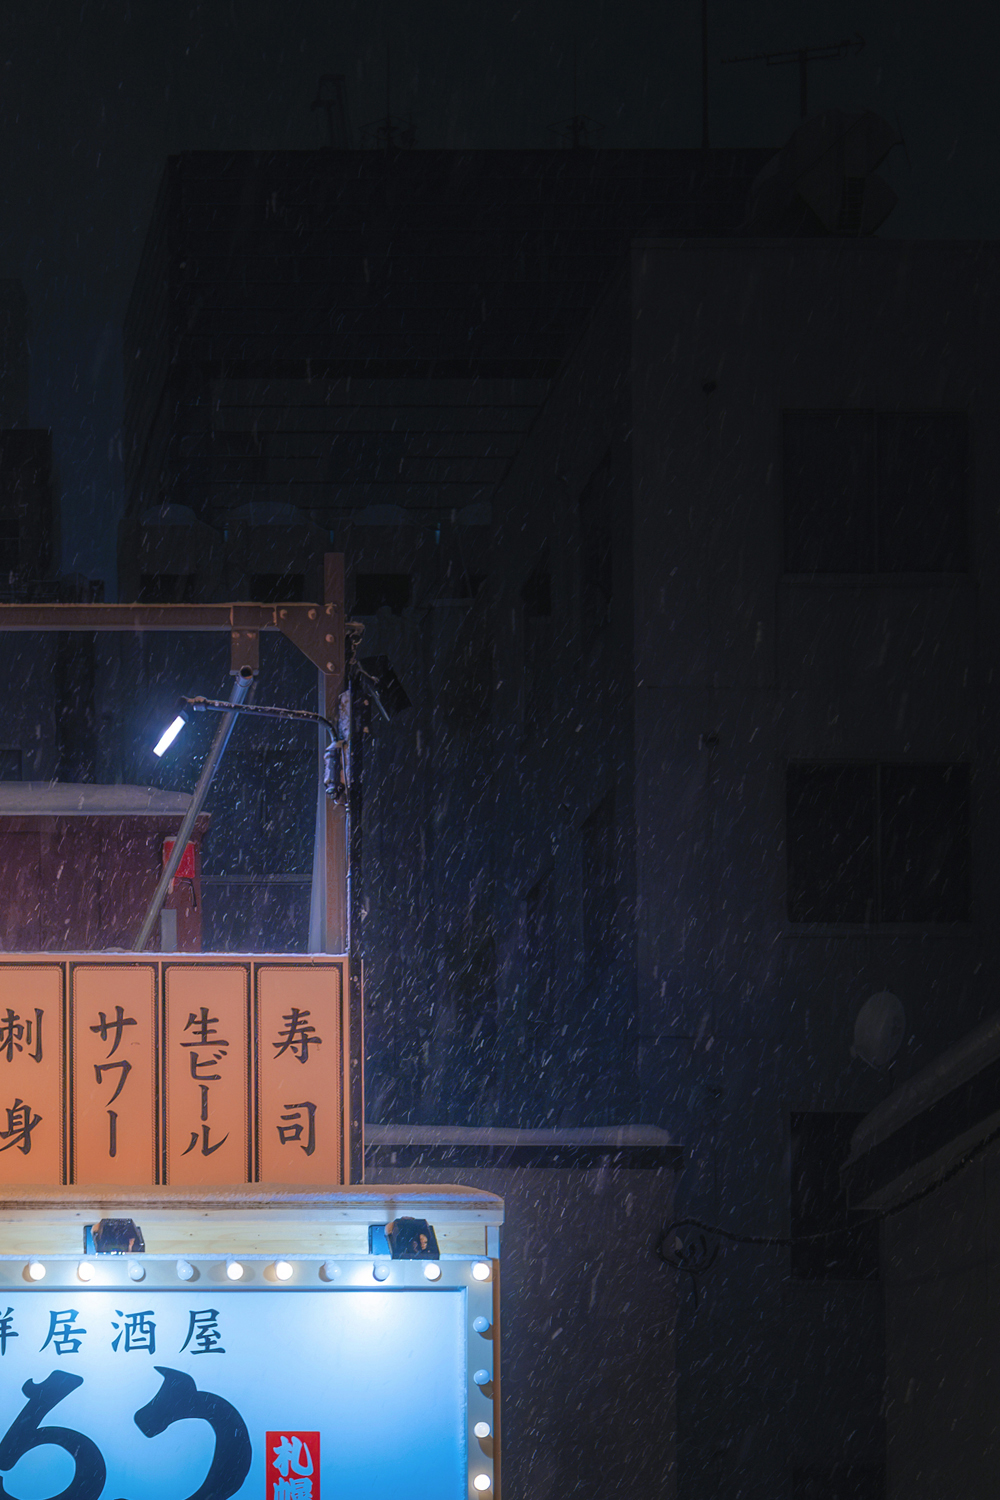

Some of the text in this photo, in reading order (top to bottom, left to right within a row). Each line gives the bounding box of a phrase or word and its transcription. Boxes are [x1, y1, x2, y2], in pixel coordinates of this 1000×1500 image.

[90, 1006, 137, 1157] サワー
[180, 1007, 229, 1156] 生ビール
[273, 1008, 321, 1156] 寿司
